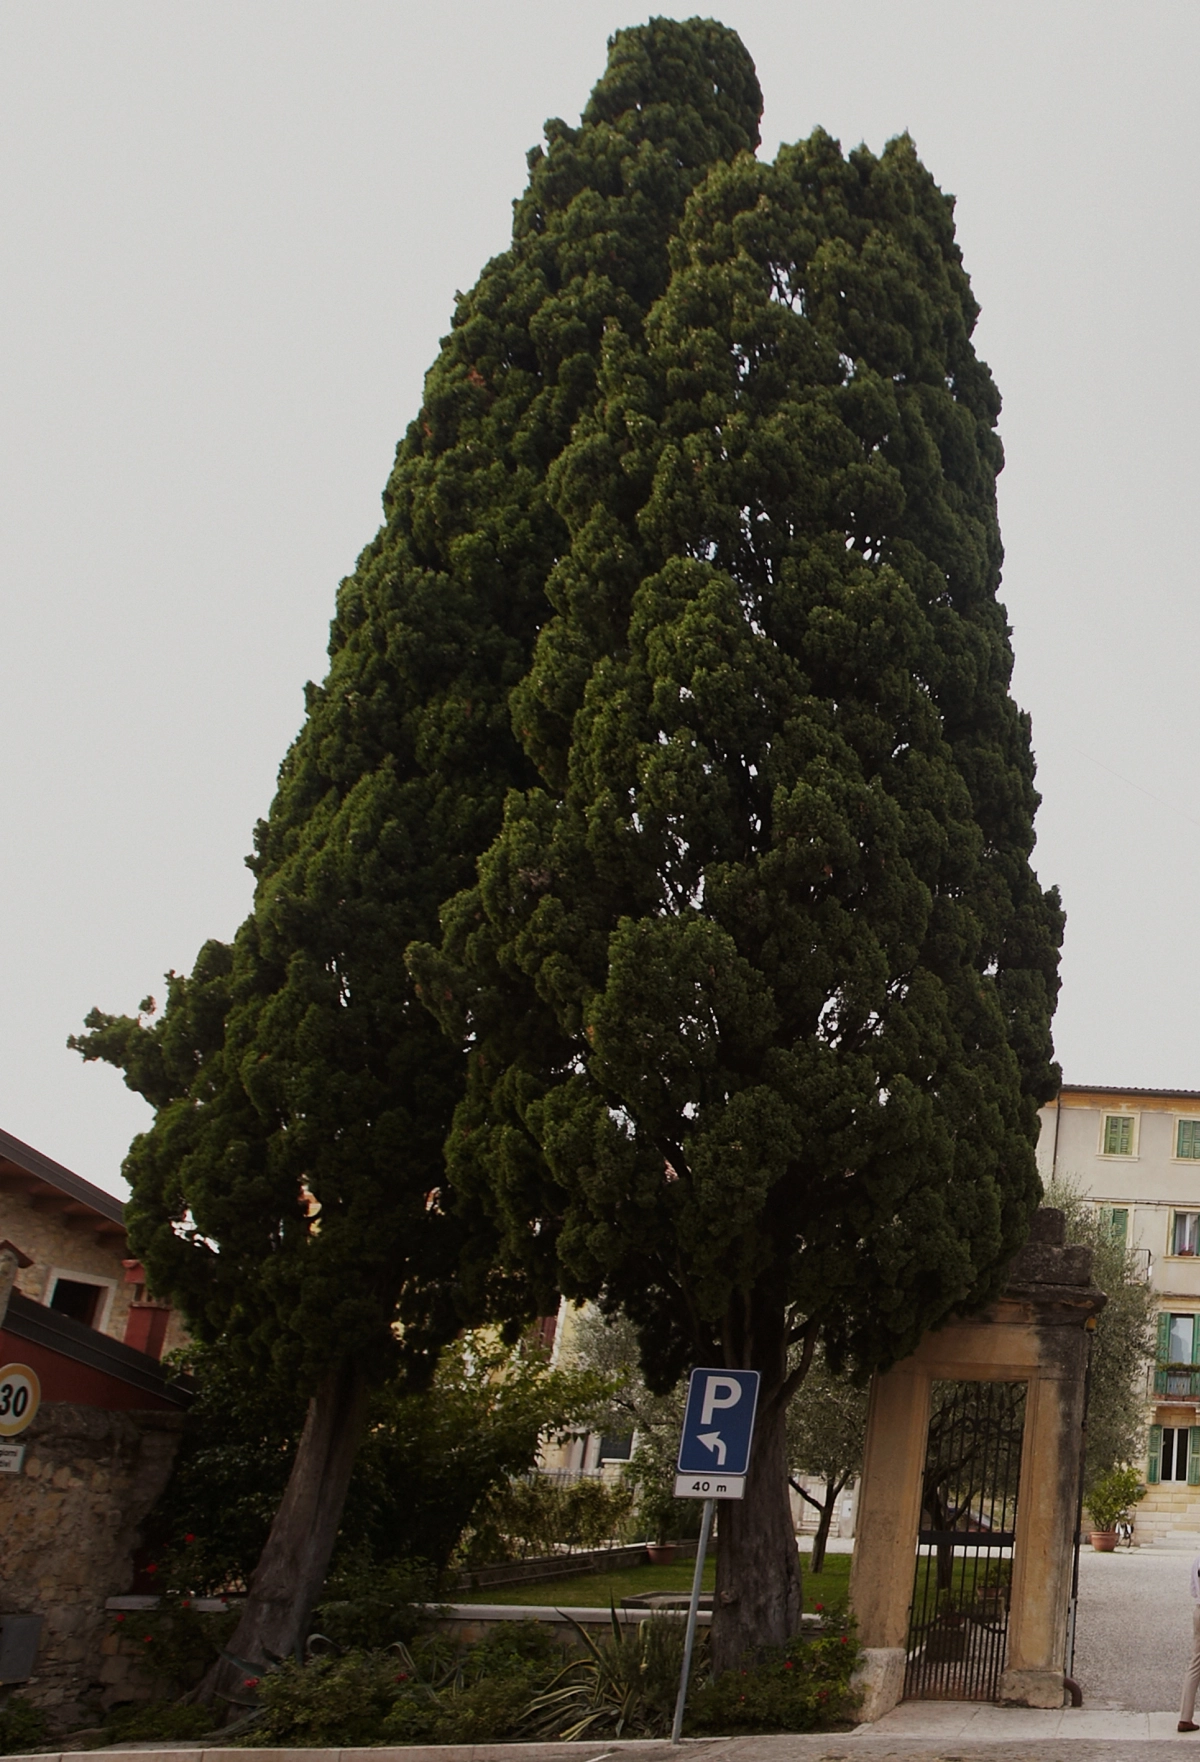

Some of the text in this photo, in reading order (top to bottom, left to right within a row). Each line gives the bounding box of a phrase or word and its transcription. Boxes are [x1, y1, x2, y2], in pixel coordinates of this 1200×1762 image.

[0, 1384, 28, 1417] 30
[701, 1376, 742, 1425] P
[692, 1481, 727, 1492] 40 m
